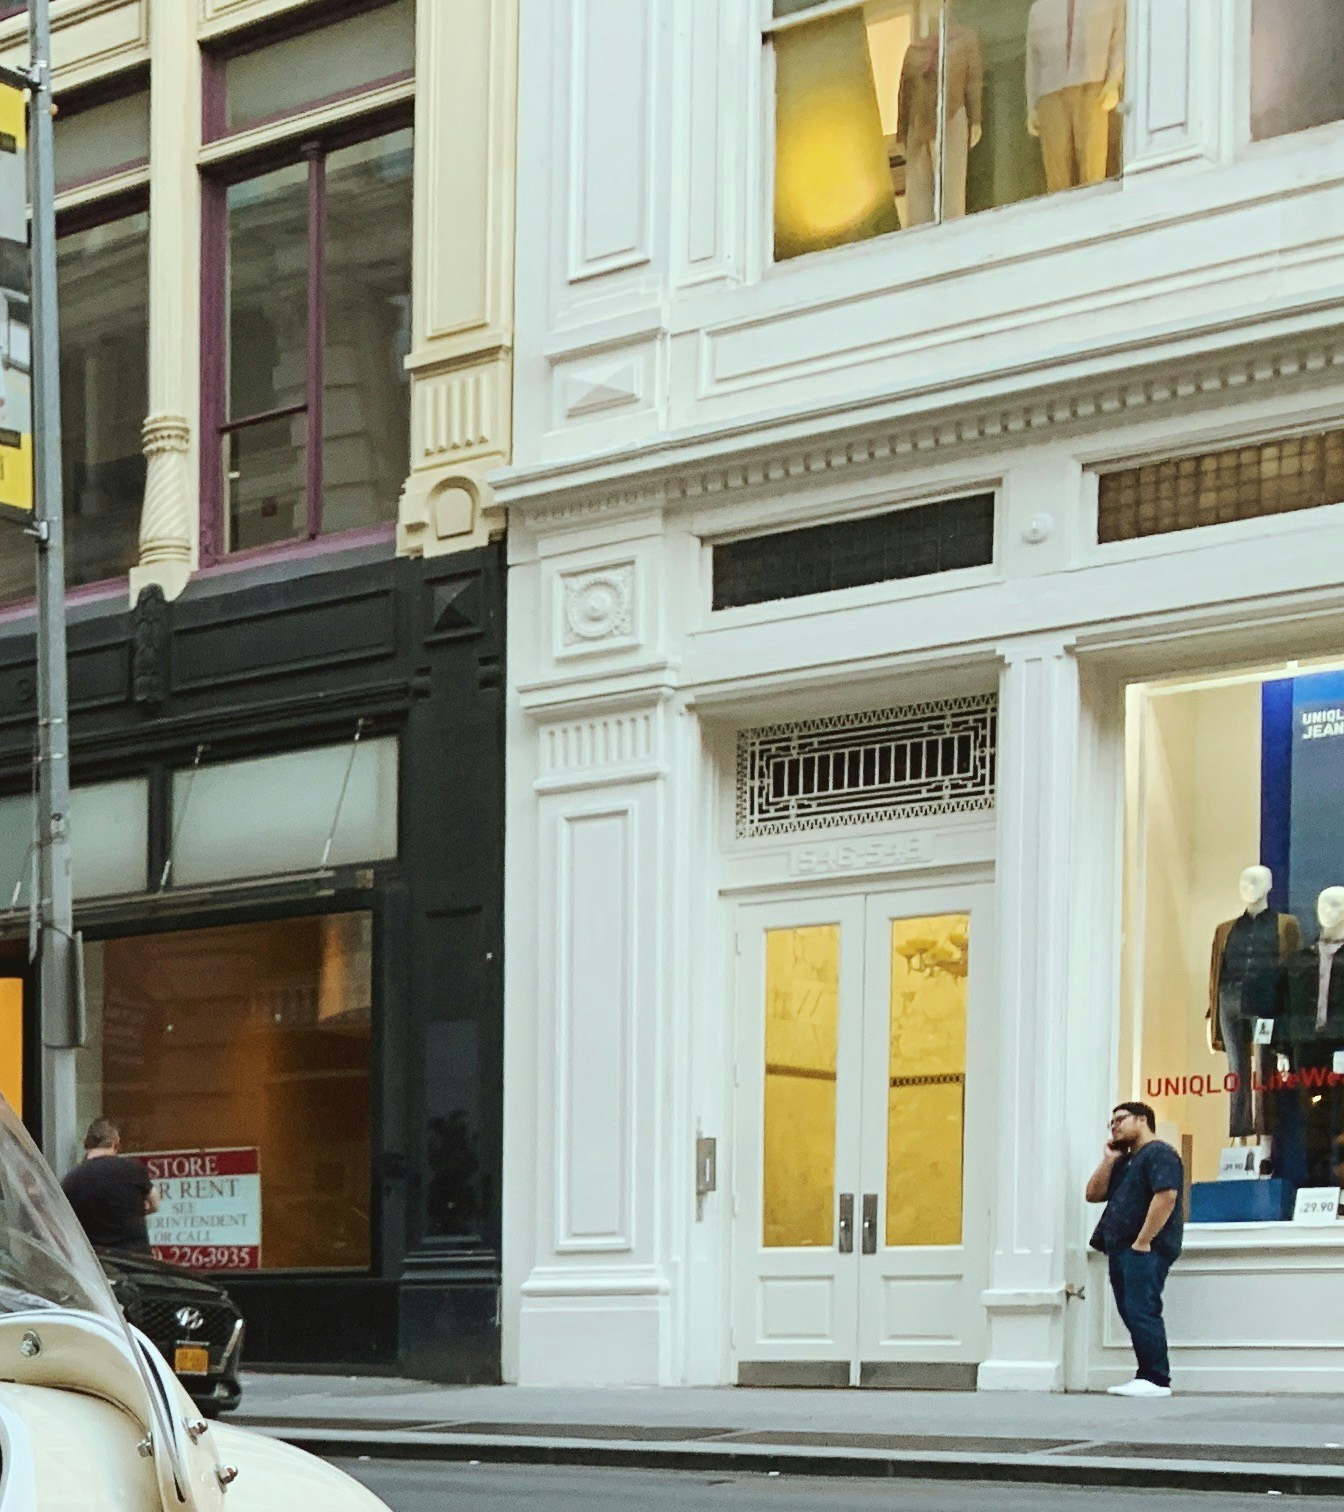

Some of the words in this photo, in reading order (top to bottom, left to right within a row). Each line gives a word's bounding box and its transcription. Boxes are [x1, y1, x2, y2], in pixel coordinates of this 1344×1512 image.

[1302, 708, 1344, 725] UNIQL
[1302, 721, 1344, 740] JEAN
[1146, 1072, 1241, 1097] UNIQLO
[1251, 1066, 1344, 1091] LifeWe
[147, 1155, 219, 1178] STORE
[180, 1178, 239, 1199] RENT
